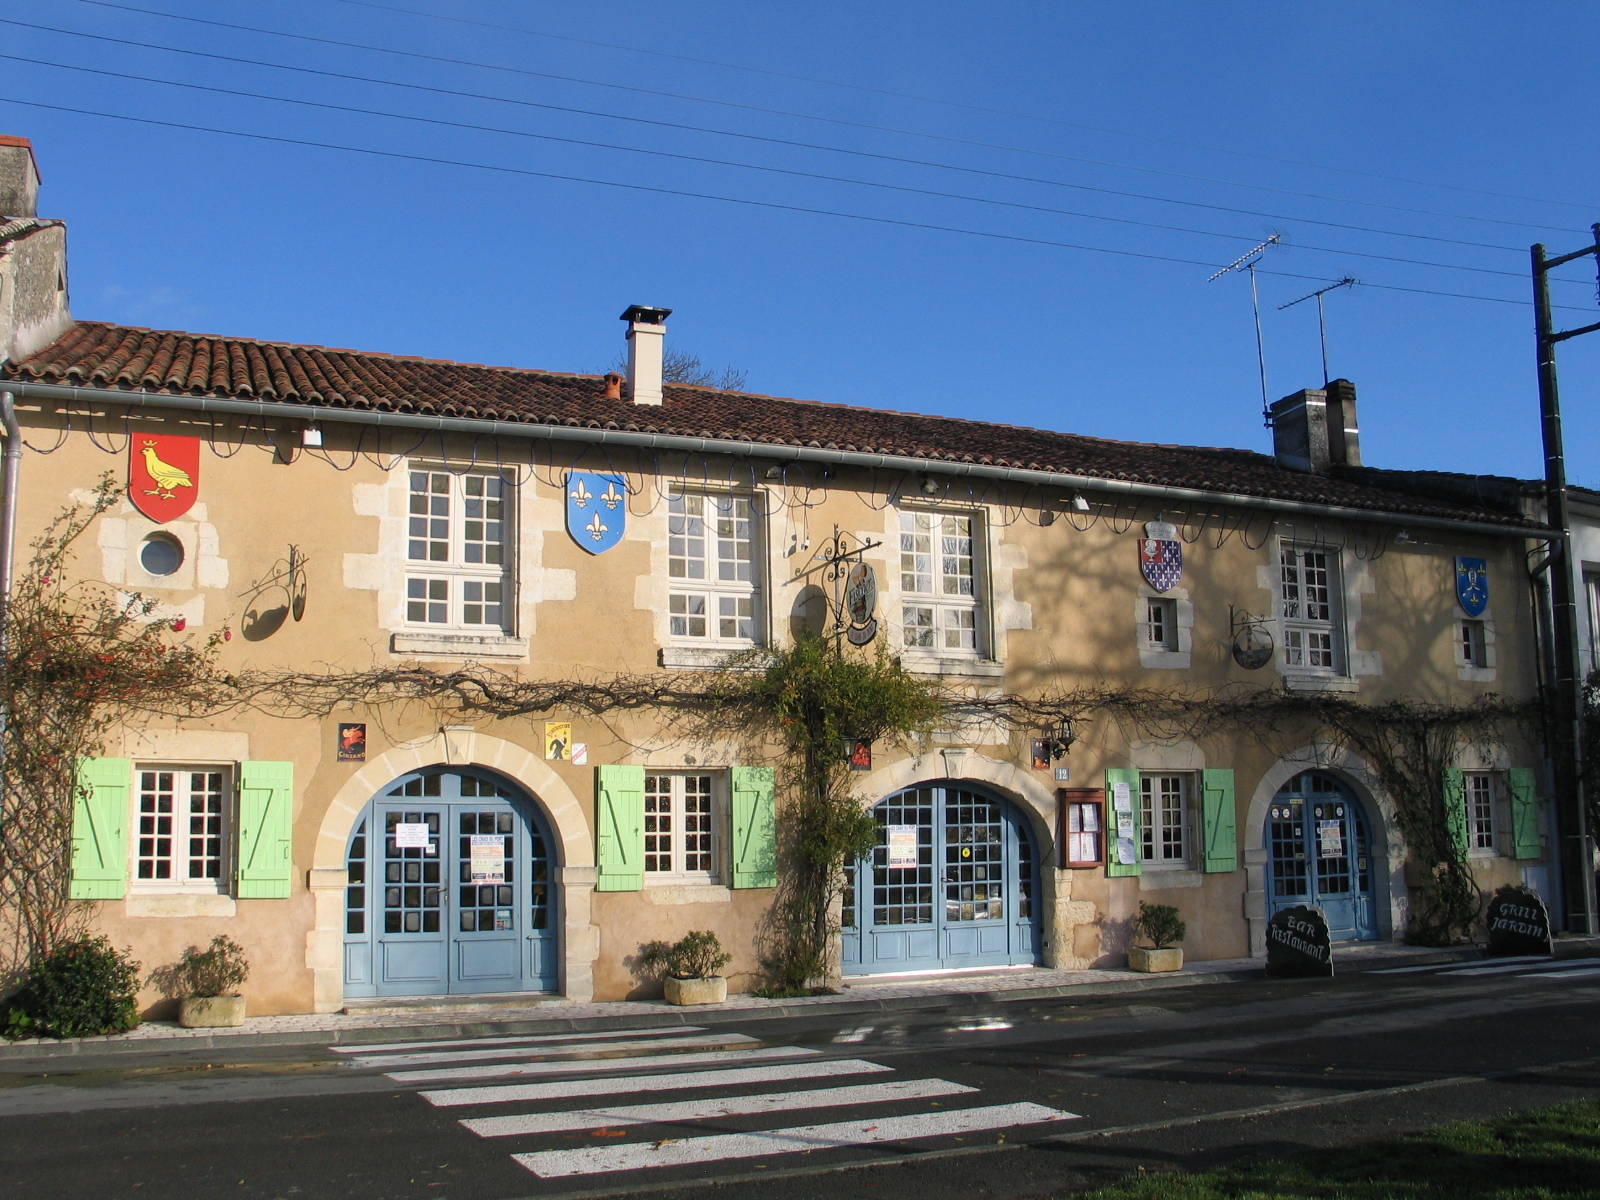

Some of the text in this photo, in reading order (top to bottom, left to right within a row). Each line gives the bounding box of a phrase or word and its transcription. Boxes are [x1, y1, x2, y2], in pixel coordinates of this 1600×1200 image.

[338, 751, 366, 759] CINZANO
[1058, 768, 1067, 779] 12
[1500, 903, 1538, 920] GRILL
[1287, 915, 1315, 938] BAR
[1490, 917, 1543, 937] JARDIN
